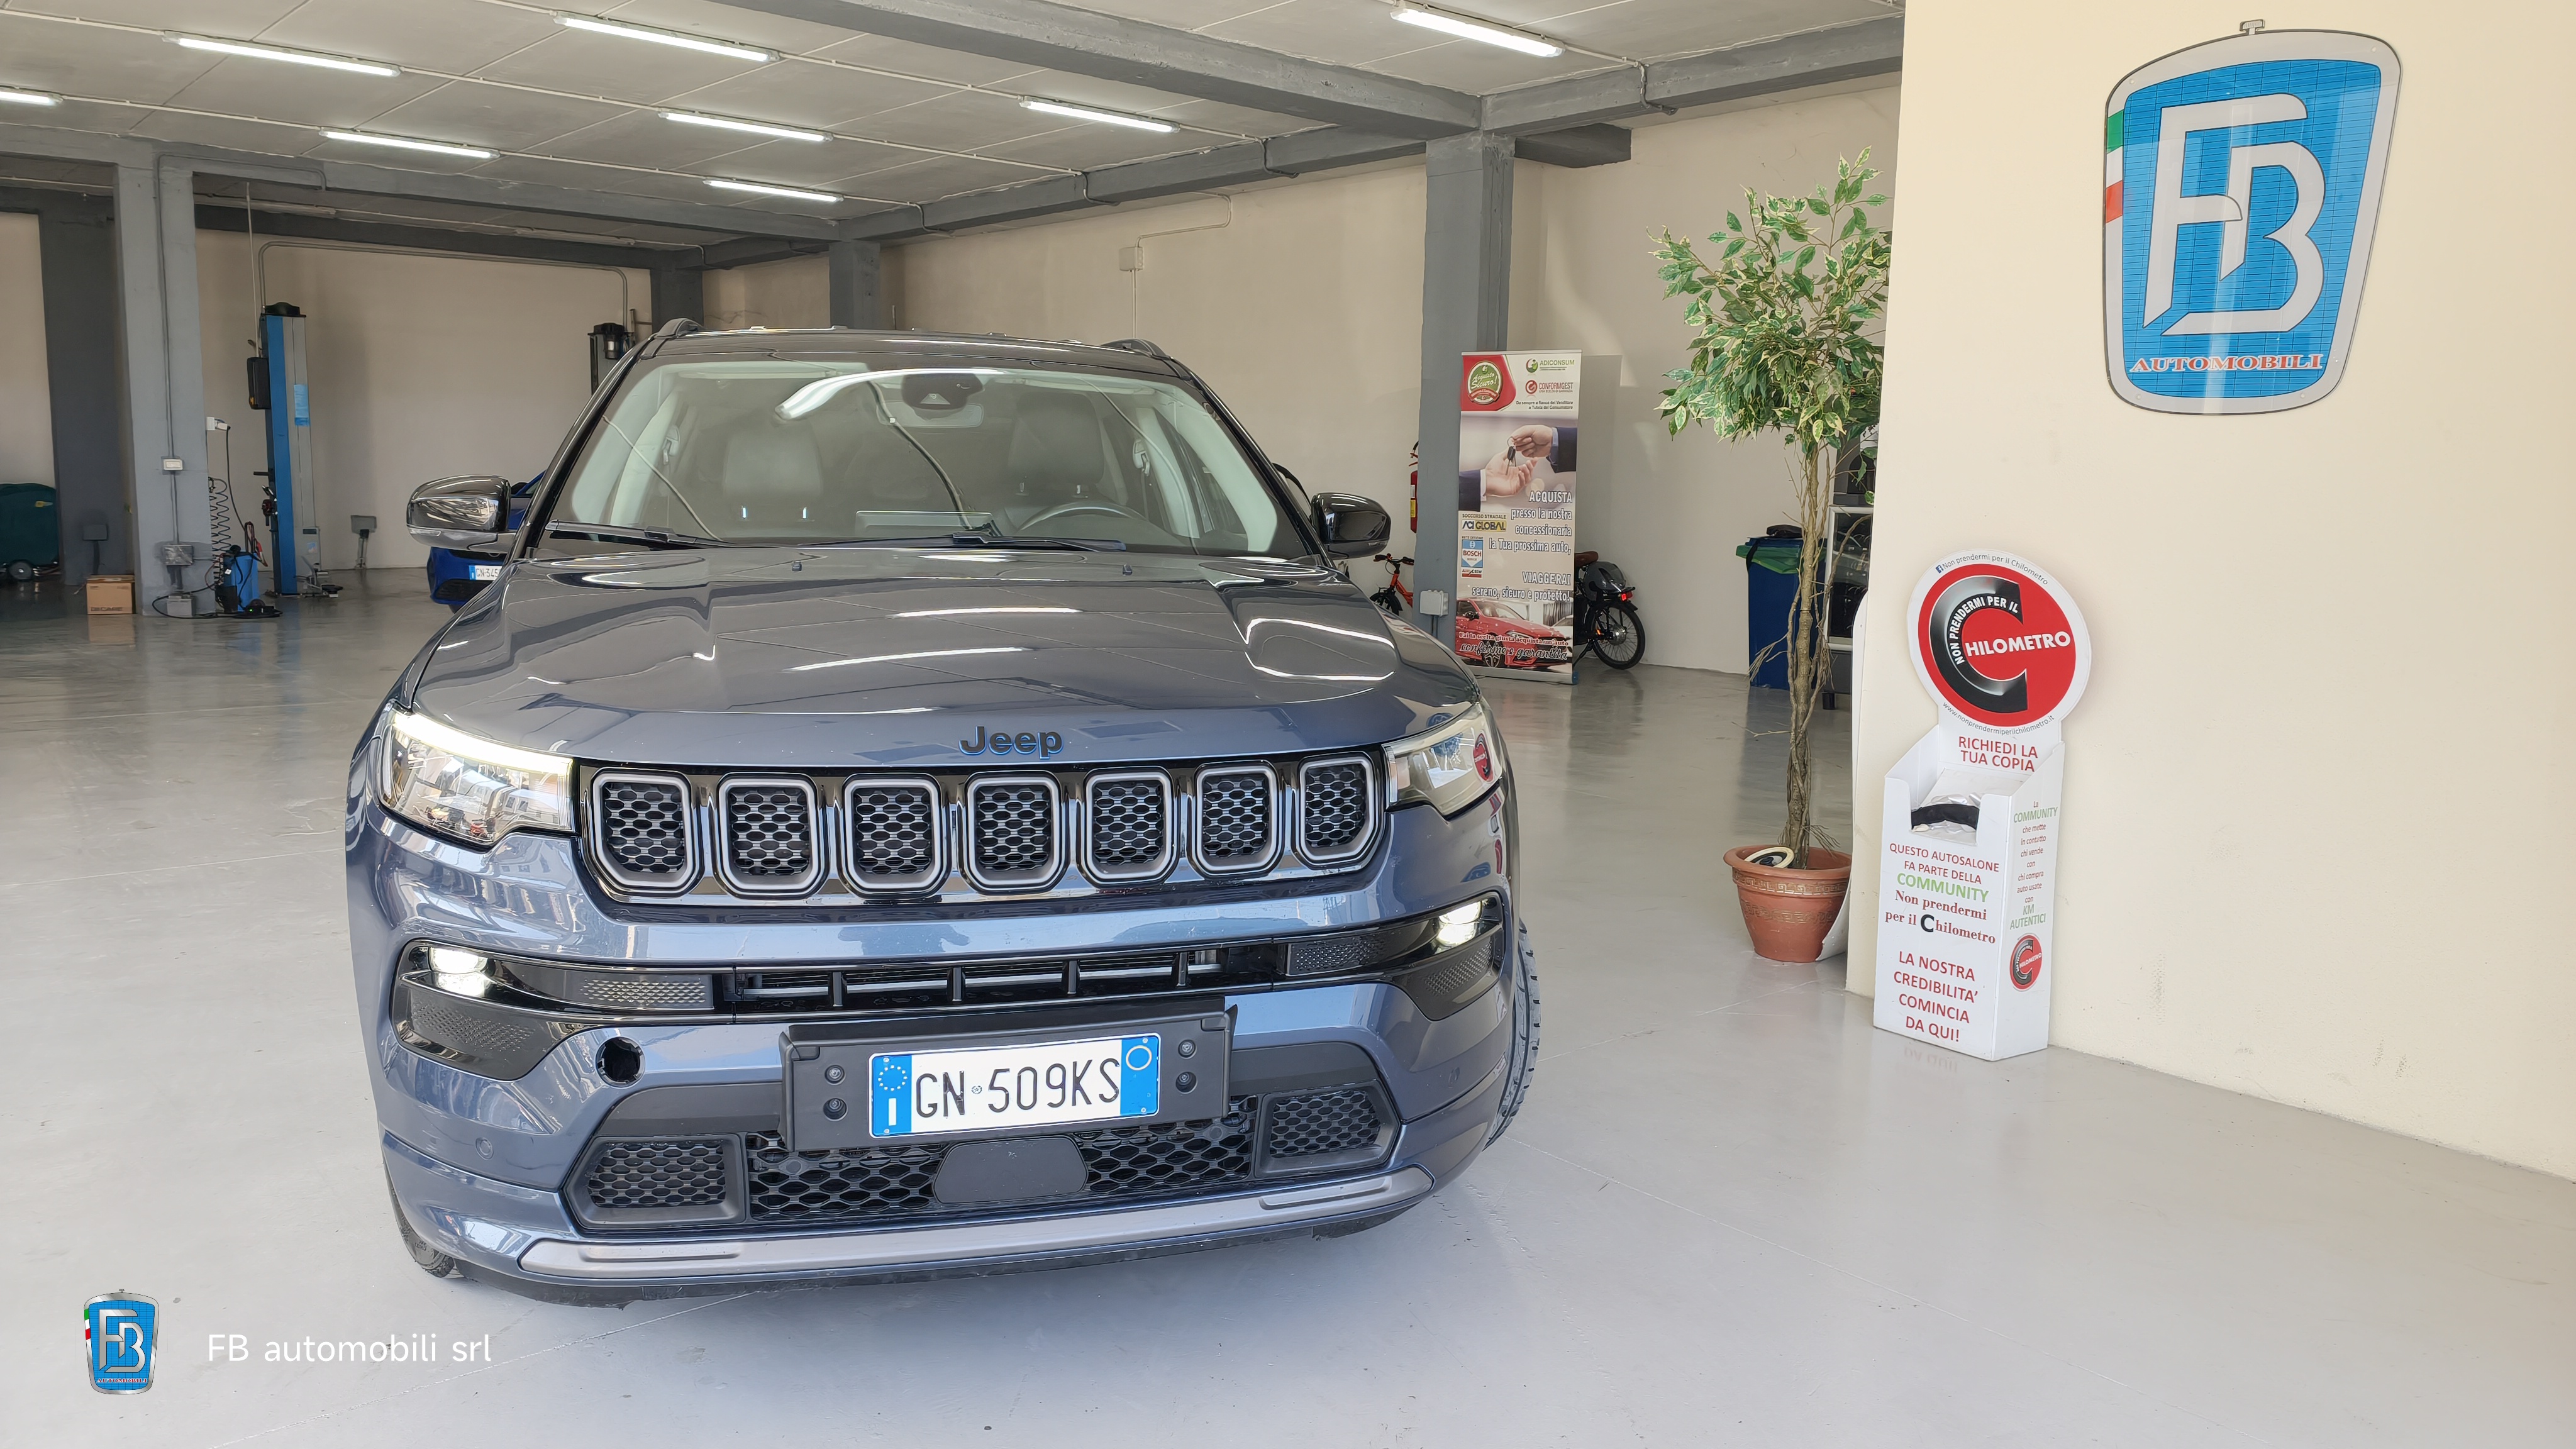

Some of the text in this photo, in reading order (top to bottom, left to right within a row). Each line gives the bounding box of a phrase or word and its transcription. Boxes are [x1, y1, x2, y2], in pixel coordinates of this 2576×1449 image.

[2129, 353, 2325, 372] AUTOMOBILI
[1471, 375, 1497, 389] Sicuro!
[1472, 372, 1495, 382] Acquisto
[1539, 382, 1574, 390] CONFORMGEST
[1529, 491, 1572, 503] ACQUISTA
[1511, 507, 1572, 520] presso la nostra
[1475, 521, 1506, 531] GLOBAL
[1515, 524, 1572, 536] concessionaria
[1489, 538, 1572, 555] la Tua prossima auto,
[486, 569, 501, 577] 345
[1943, 560, 1956, 570] Non
[1956, 553, 1990, 565] prendermi
[2011, 560, 2048, 586] Chilometro
[1522, 571, 1572, 586] VIAGGERAI
[1472, 586, 1571, 601] sereno, sicuro e protetto!
[1950, 596, 2019, 665] NON PRENDERMI PER IL
[1460, 641, 1568, 660] conforme e garantita
[1942, 702, 2055, 736] www.nonprendermiperilchilometro.it
[958, 726, 1063, 760] Jeep
[1958, 736, 2038, 758] RICHIEDI LA
[1960, 750, 2035, 772] TUA COPIA
[2013, 806, 2058, 823] COMMUNITY
[2022, 823, 2046, 833] che mette
[2026, 835, 2046, 844] contatto
[1889, 843, 2000, 872] QUESTO AUTOSALONE
[2028, 847, 2043, 856] vende
[1904, 861, 1982, 884] FA PARTE DELLA
[2026, 870, 2044, 881] compra
[1897, 872, 1989, 902] COMMUNITY
[2016, 882, 2042, 894] auto usate
[1895, 890, 1987, 921] Non prendermi
[2023, 904, 2035, 916] KM
[1885, 911, 1996, 945] per il Chilometro
[2009, 913, 2046, 930] AUTENTICI
[1899, 951, 1975, 982] LA NOSTRA
[1894, 971, 1979, 1004] CREDIBILITA'
[1899, 993, 1970, 1024] COMINCIA
[1906, 1016, 1960, 1043] DA QUI!
[888, 1097, 897, 1126] I
